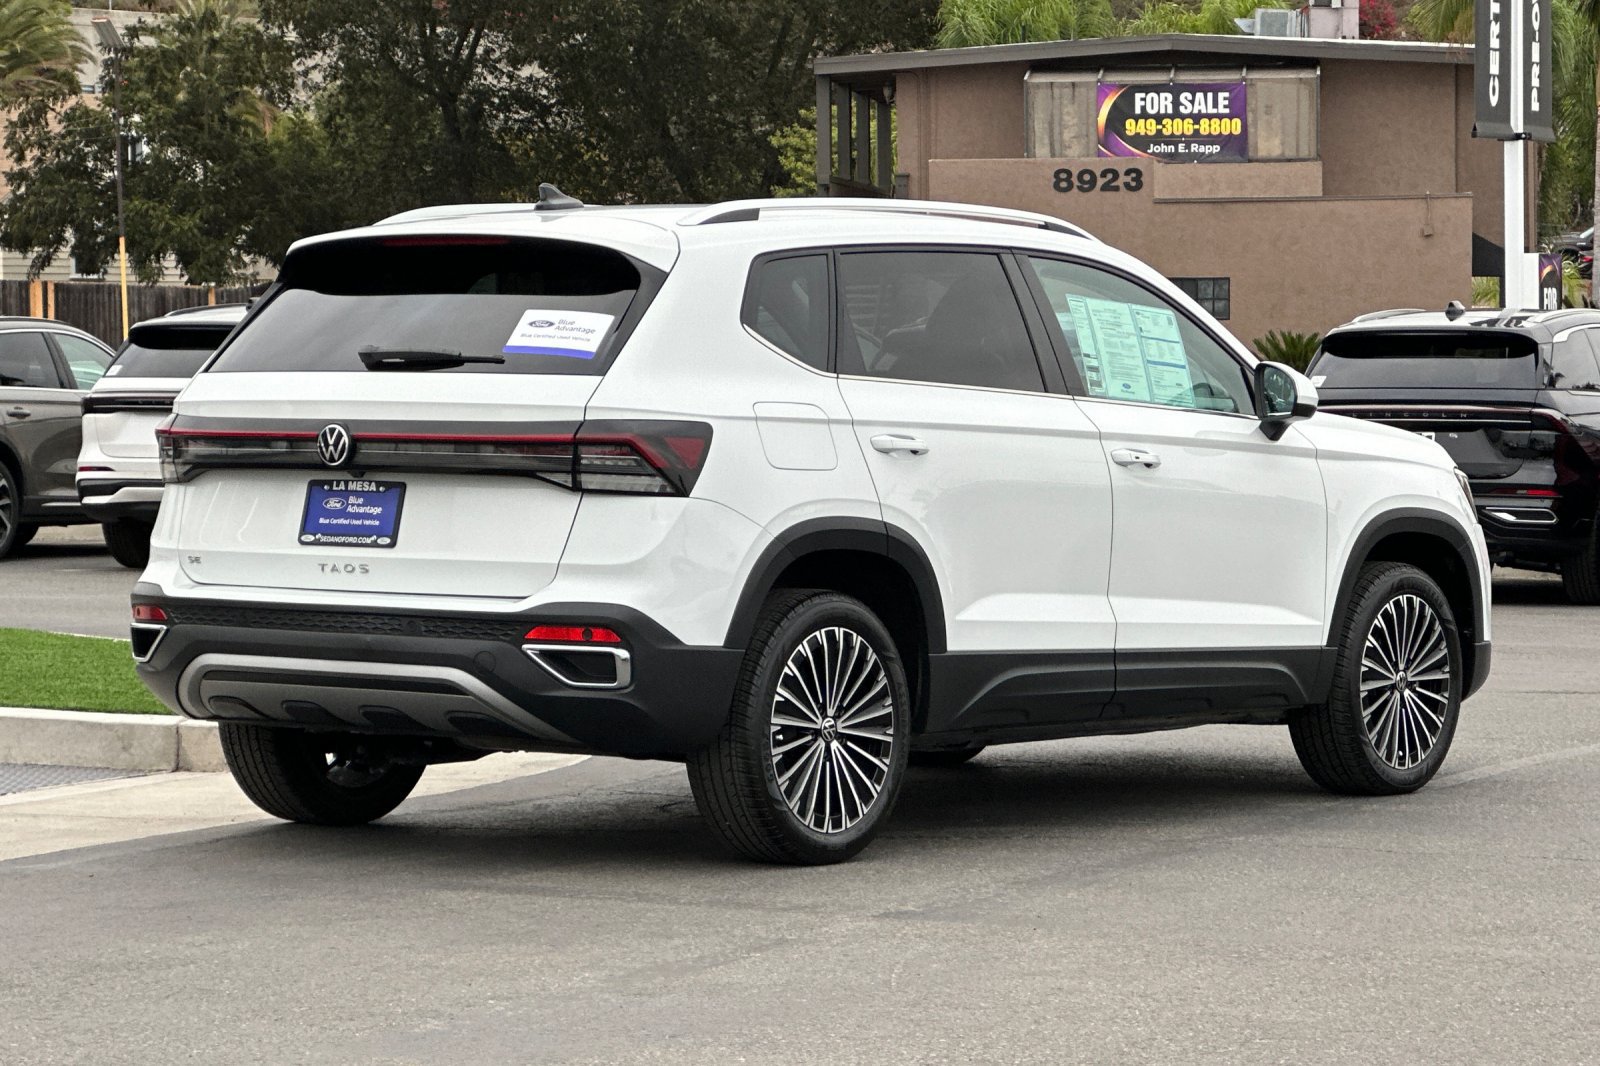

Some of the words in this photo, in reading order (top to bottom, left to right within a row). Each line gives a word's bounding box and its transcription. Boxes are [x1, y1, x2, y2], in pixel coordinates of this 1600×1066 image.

[1531, 0, 1540, 112] PRE-O
[1134, 92, 1174, 114] FOR
[1179, 92, 1230, 114] SALE
[1125, 118, 1242, 136] 949-306-8800
[1147, 143, 1175, 154] John
[1178, 143, 1189, 153] E.
[1191, 143, 1221, 155] Rapp
[1052, 168, 1144, 193] 8923
[332, 481, 345, 491] LA
[347, 481, 377, 492] MESA
[348, 496, 364, 504] Blue
[346, 505, 382, 514] Advantage
[319, 563, 369, 574] TAOS
